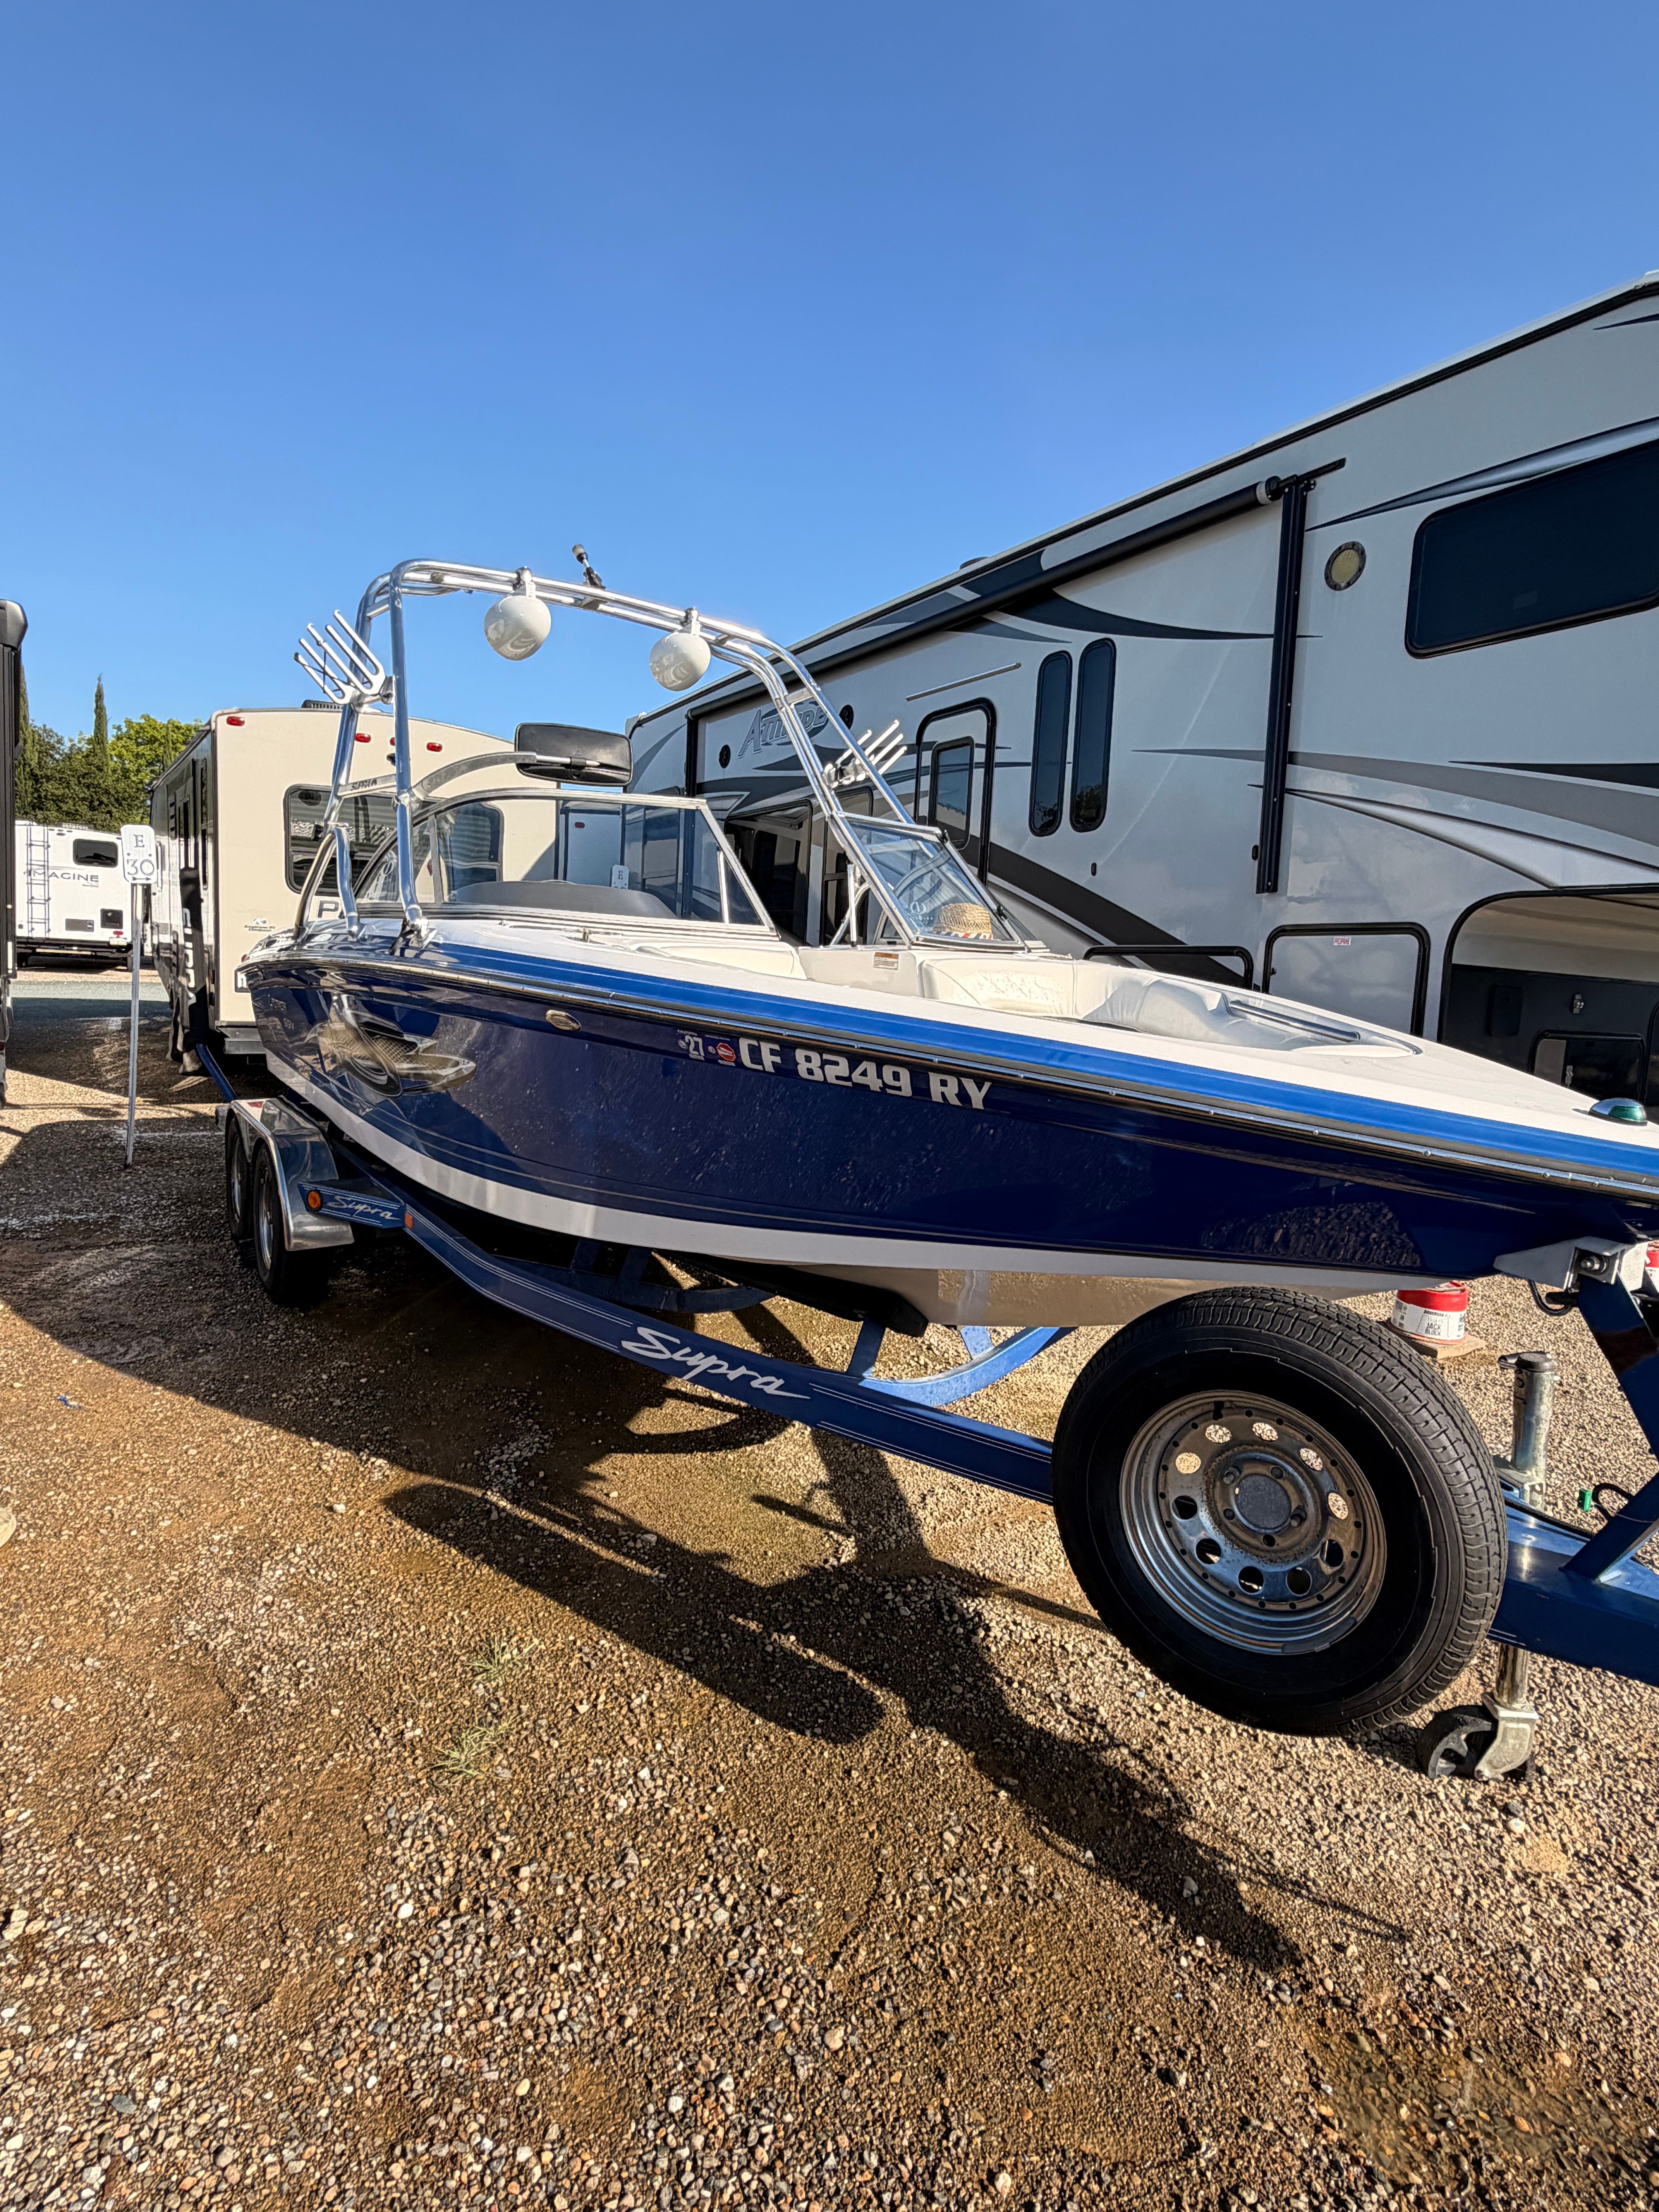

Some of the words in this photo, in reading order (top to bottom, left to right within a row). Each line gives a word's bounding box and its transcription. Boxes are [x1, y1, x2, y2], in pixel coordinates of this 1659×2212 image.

[133, 834, 145, 848] E
[126, 859, 155, 876] 30
[618, 870, 623, 880] E
[685, 1035, 705, 1056] 27
[739, 1037, 781, 1073] CF
[795, 1048, 912, 1097] 8249
[927, 1071, 992, 1110] RY
[326, 1195, 400, 1220] Supra
[621, 1327, 811, 1399] Supra
